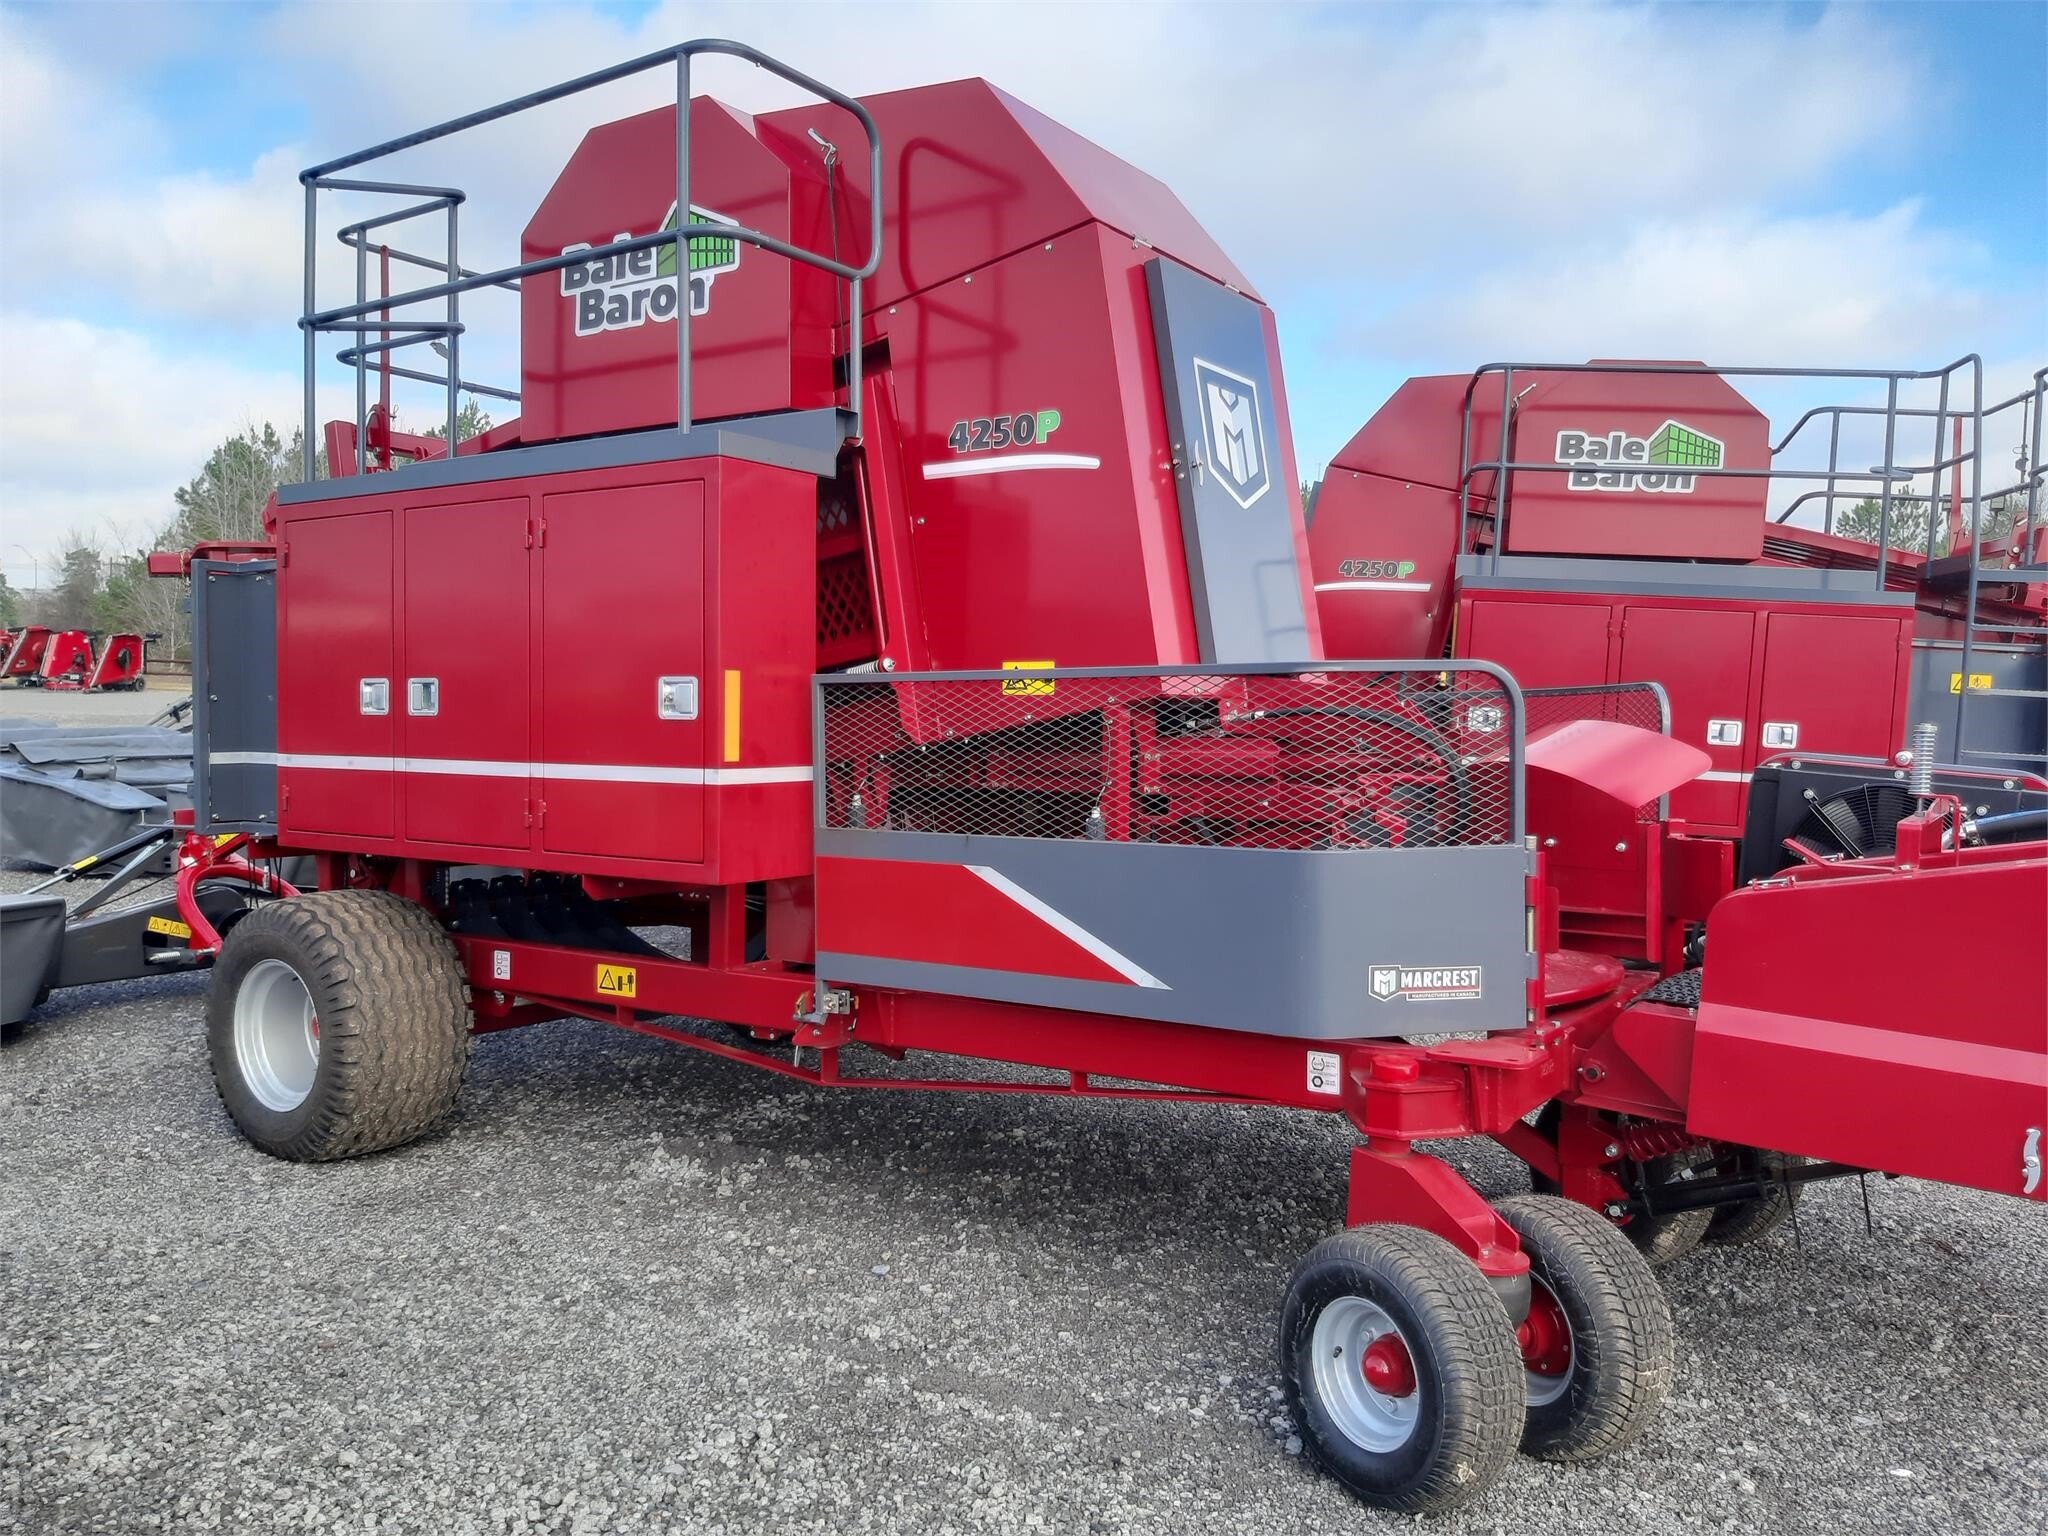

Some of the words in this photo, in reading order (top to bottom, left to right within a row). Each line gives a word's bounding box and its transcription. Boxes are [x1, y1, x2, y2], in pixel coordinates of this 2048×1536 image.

[579, 276, 706, 330] Baron
[948, 410, 1061, 453] 4250P
[1559, 434, 1645, 461] Bale
[1571, 462, 1692, 489] Baron
[1339, 560, 1415, 579] 4250P
[1400, 970, 1478, 988] MARCREST
